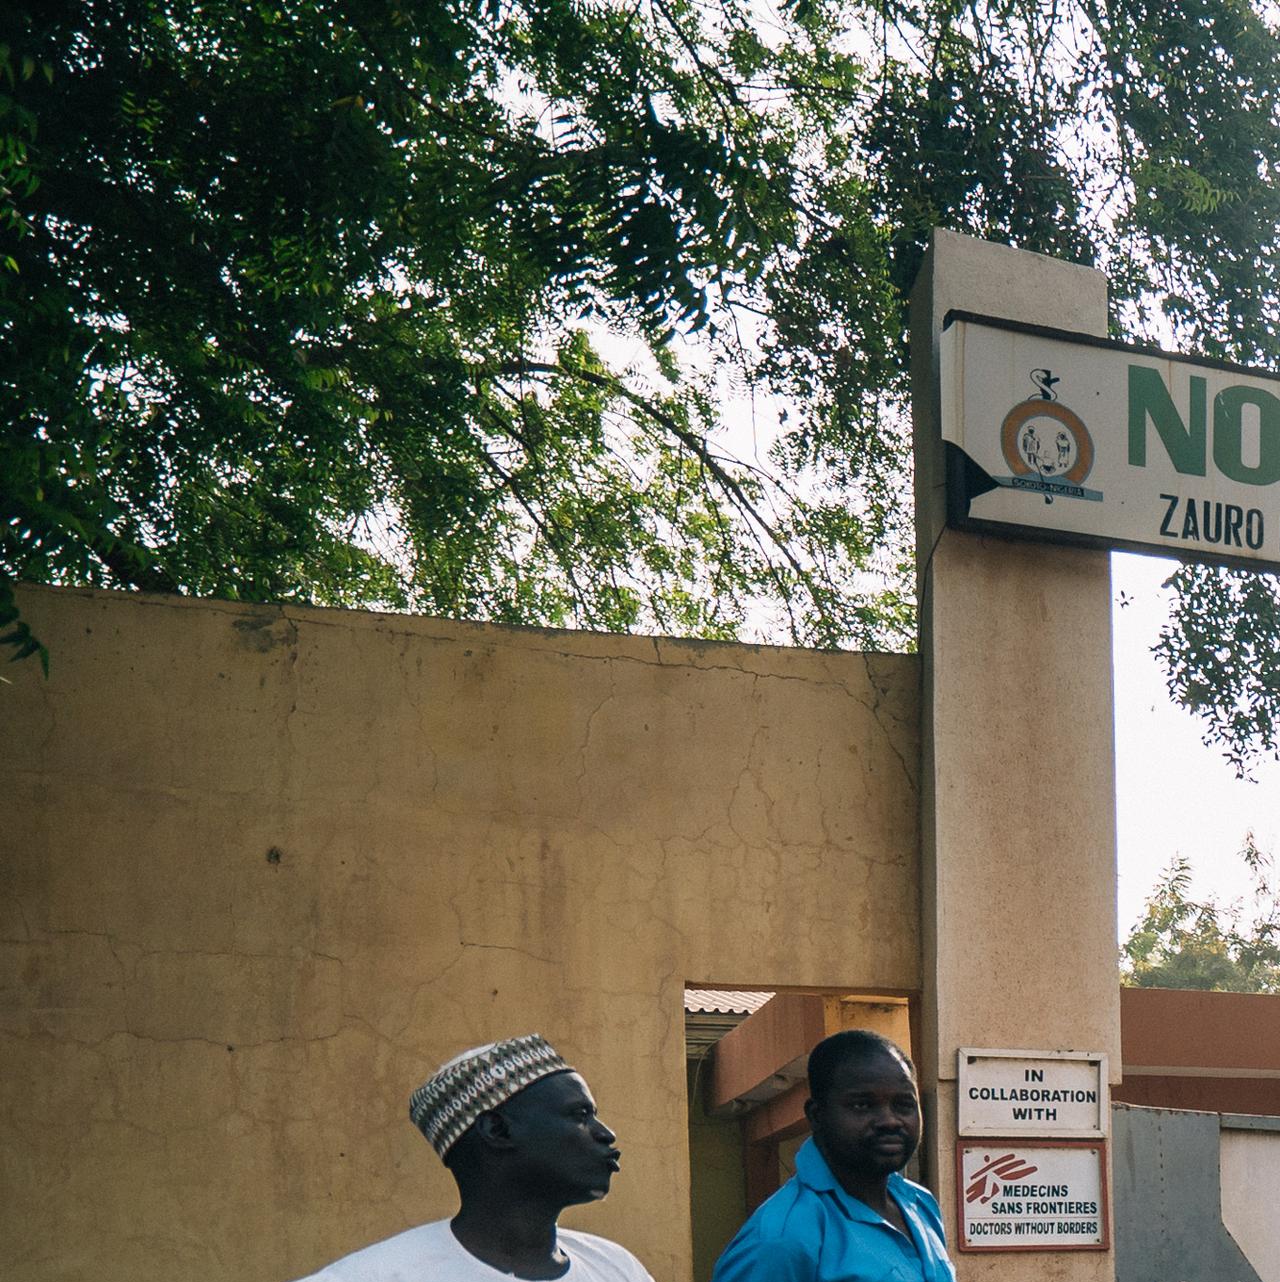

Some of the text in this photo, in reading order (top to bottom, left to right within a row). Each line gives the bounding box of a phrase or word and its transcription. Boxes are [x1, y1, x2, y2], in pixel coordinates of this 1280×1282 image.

[1159, 493, 1264, 550] ZAURO
[1024, 1069, 1044, 1082] IN
[968, 1087, 1097, 1103] COLLABORATION
[1012, 1107, 1057, 1121] WITH
[1002, 1184, 1069, 1197] MEDECINS
[991, 1201, 1098, 1214] SANS FRONTIERES
[969, 1221, 1098, 1235] DOCTORS WITHOUT BORDERS
